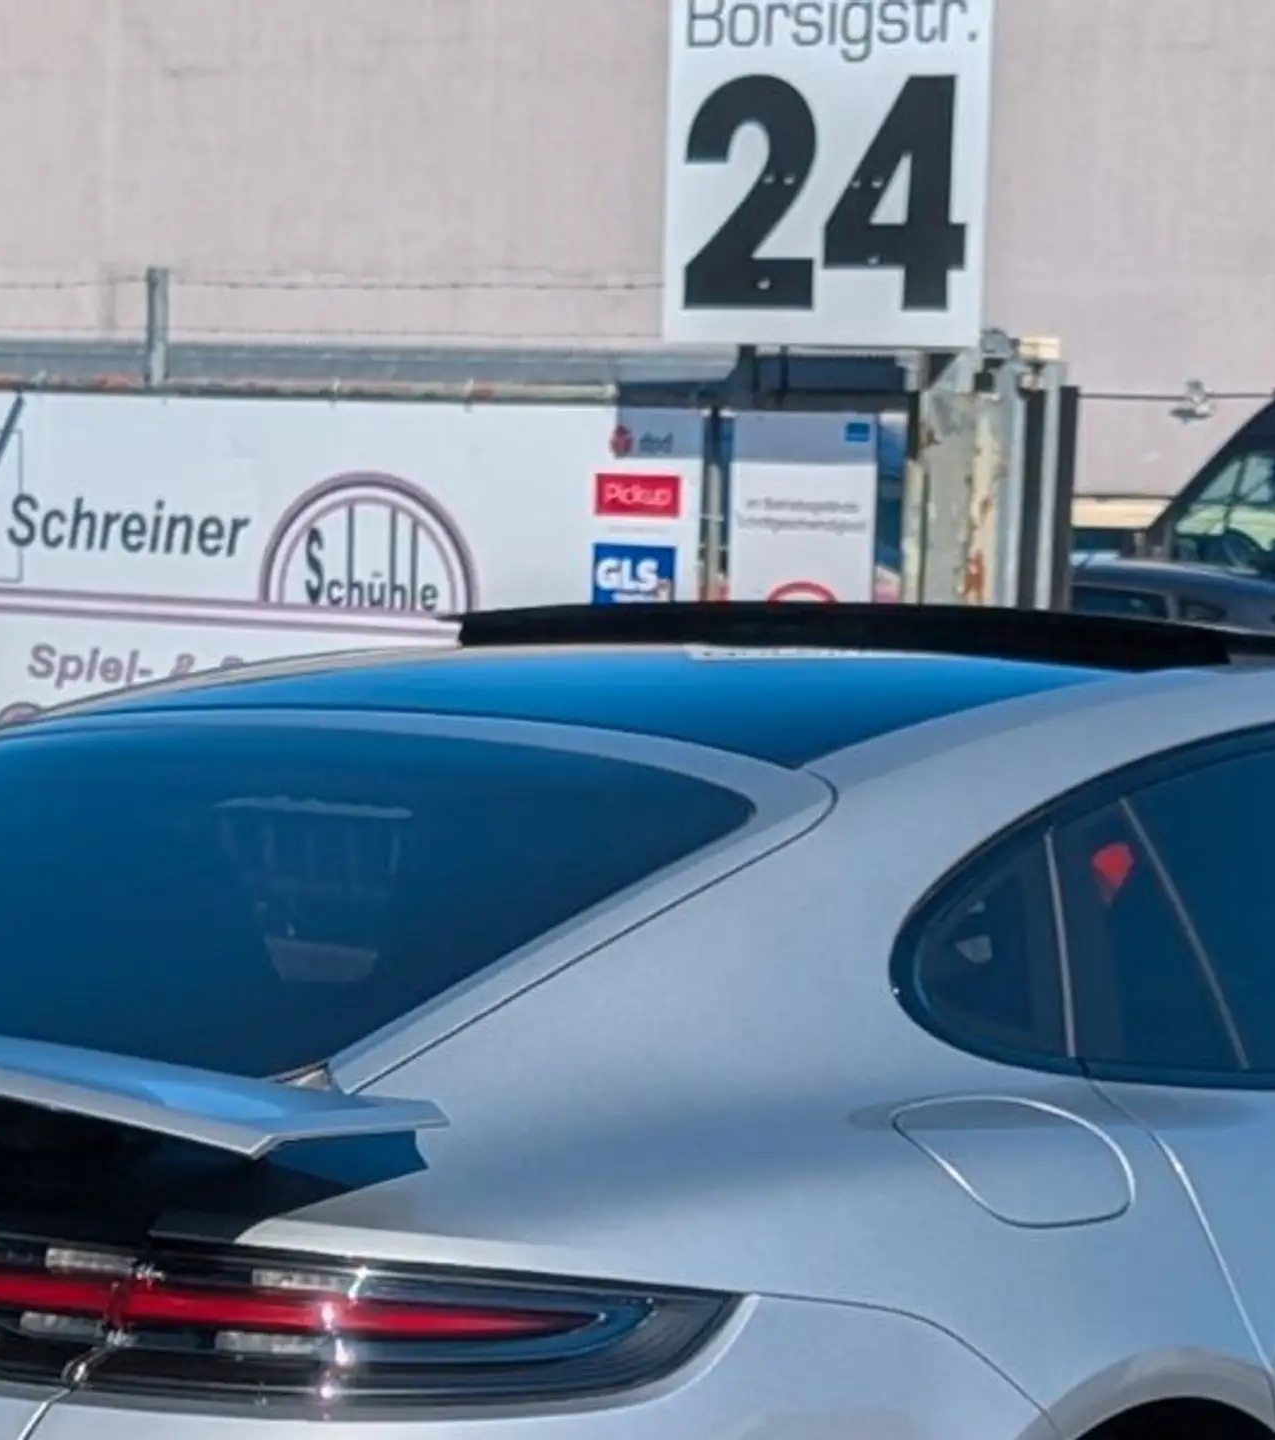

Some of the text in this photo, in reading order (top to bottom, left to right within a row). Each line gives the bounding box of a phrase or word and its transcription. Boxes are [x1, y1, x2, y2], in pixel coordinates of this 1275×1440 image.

[686, 0, 979, 62] Borsigstr.
[683, 73, 967, 311] 24
[7, 493, 250, 559] Schreiner
[304, 502, 439, 612] Schühle
[596, 557, 659, 592] GLS
